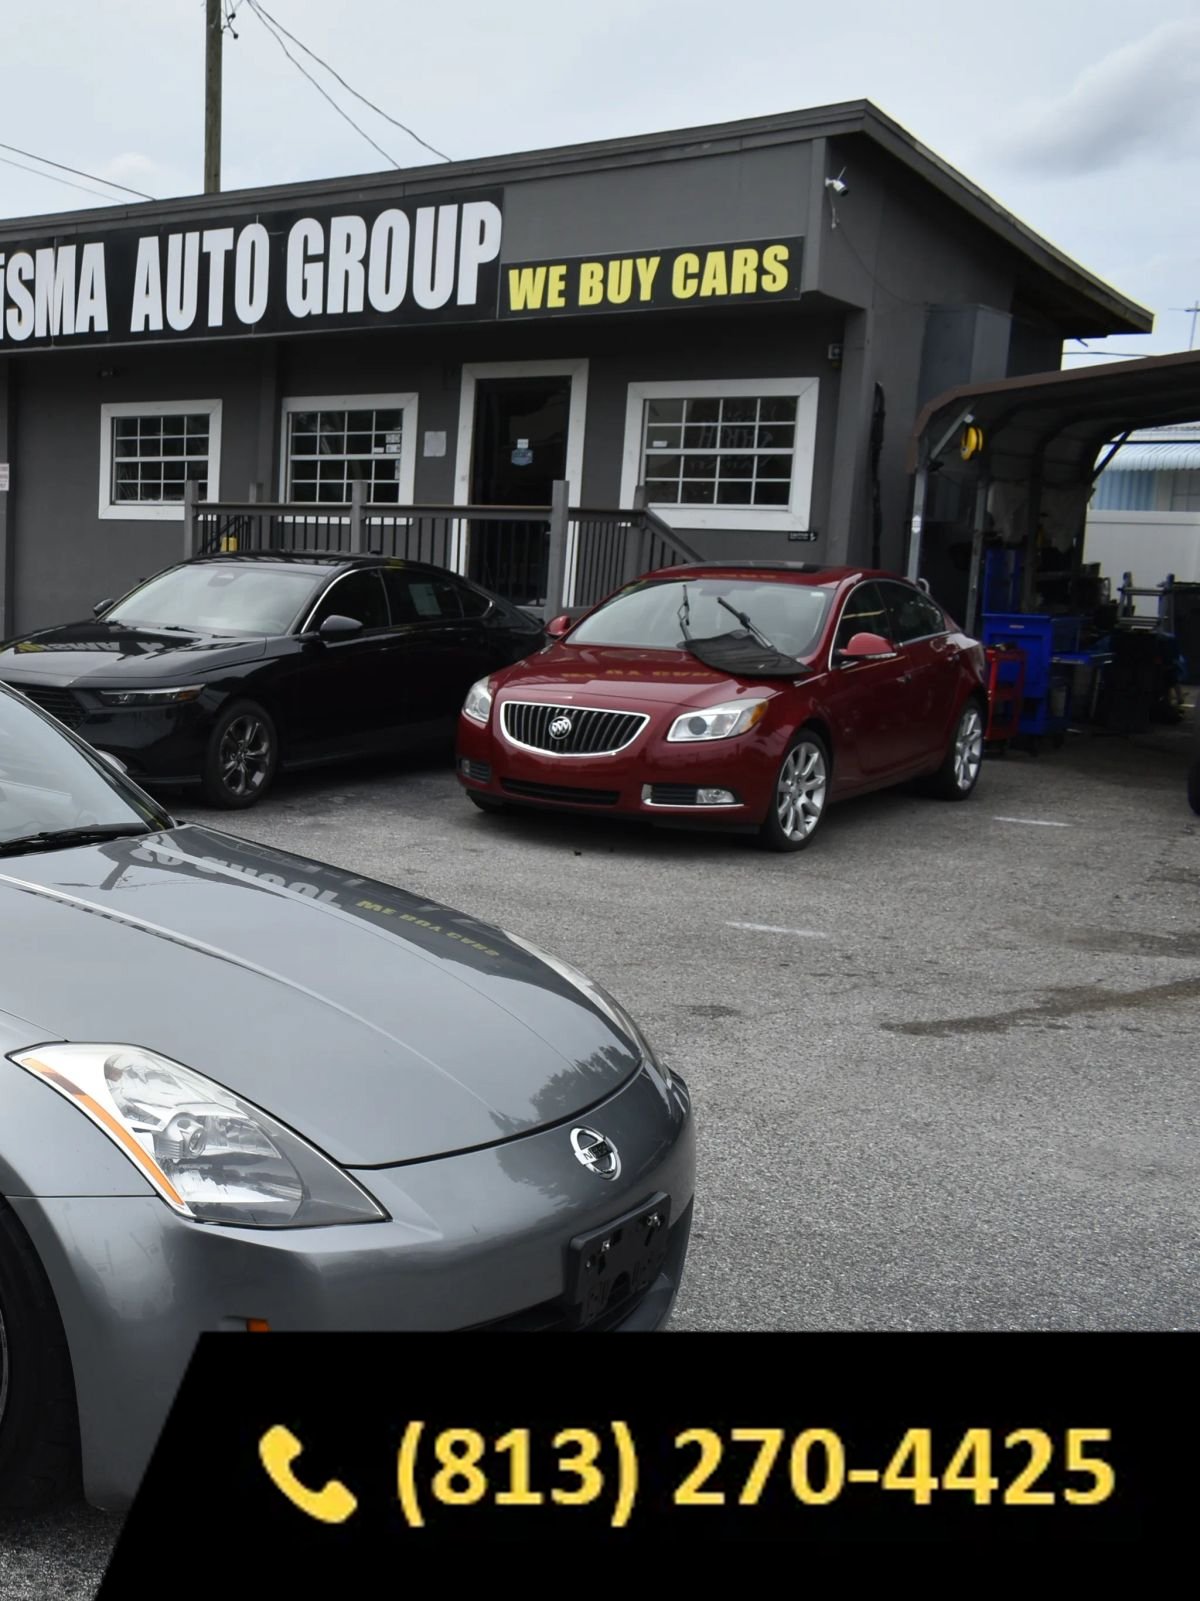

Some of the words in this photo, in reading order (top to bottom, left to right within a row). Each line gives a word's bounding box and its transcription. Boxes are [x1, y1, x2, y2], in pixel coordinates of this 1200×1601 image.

[130, 223, 270, 332] AUTO
[286, 200, 503, 318] GROUP
[508, 265, 567, 311] WE
[578, 256, 661, 306] BUY
[671, 244, 789, 299] CARS
